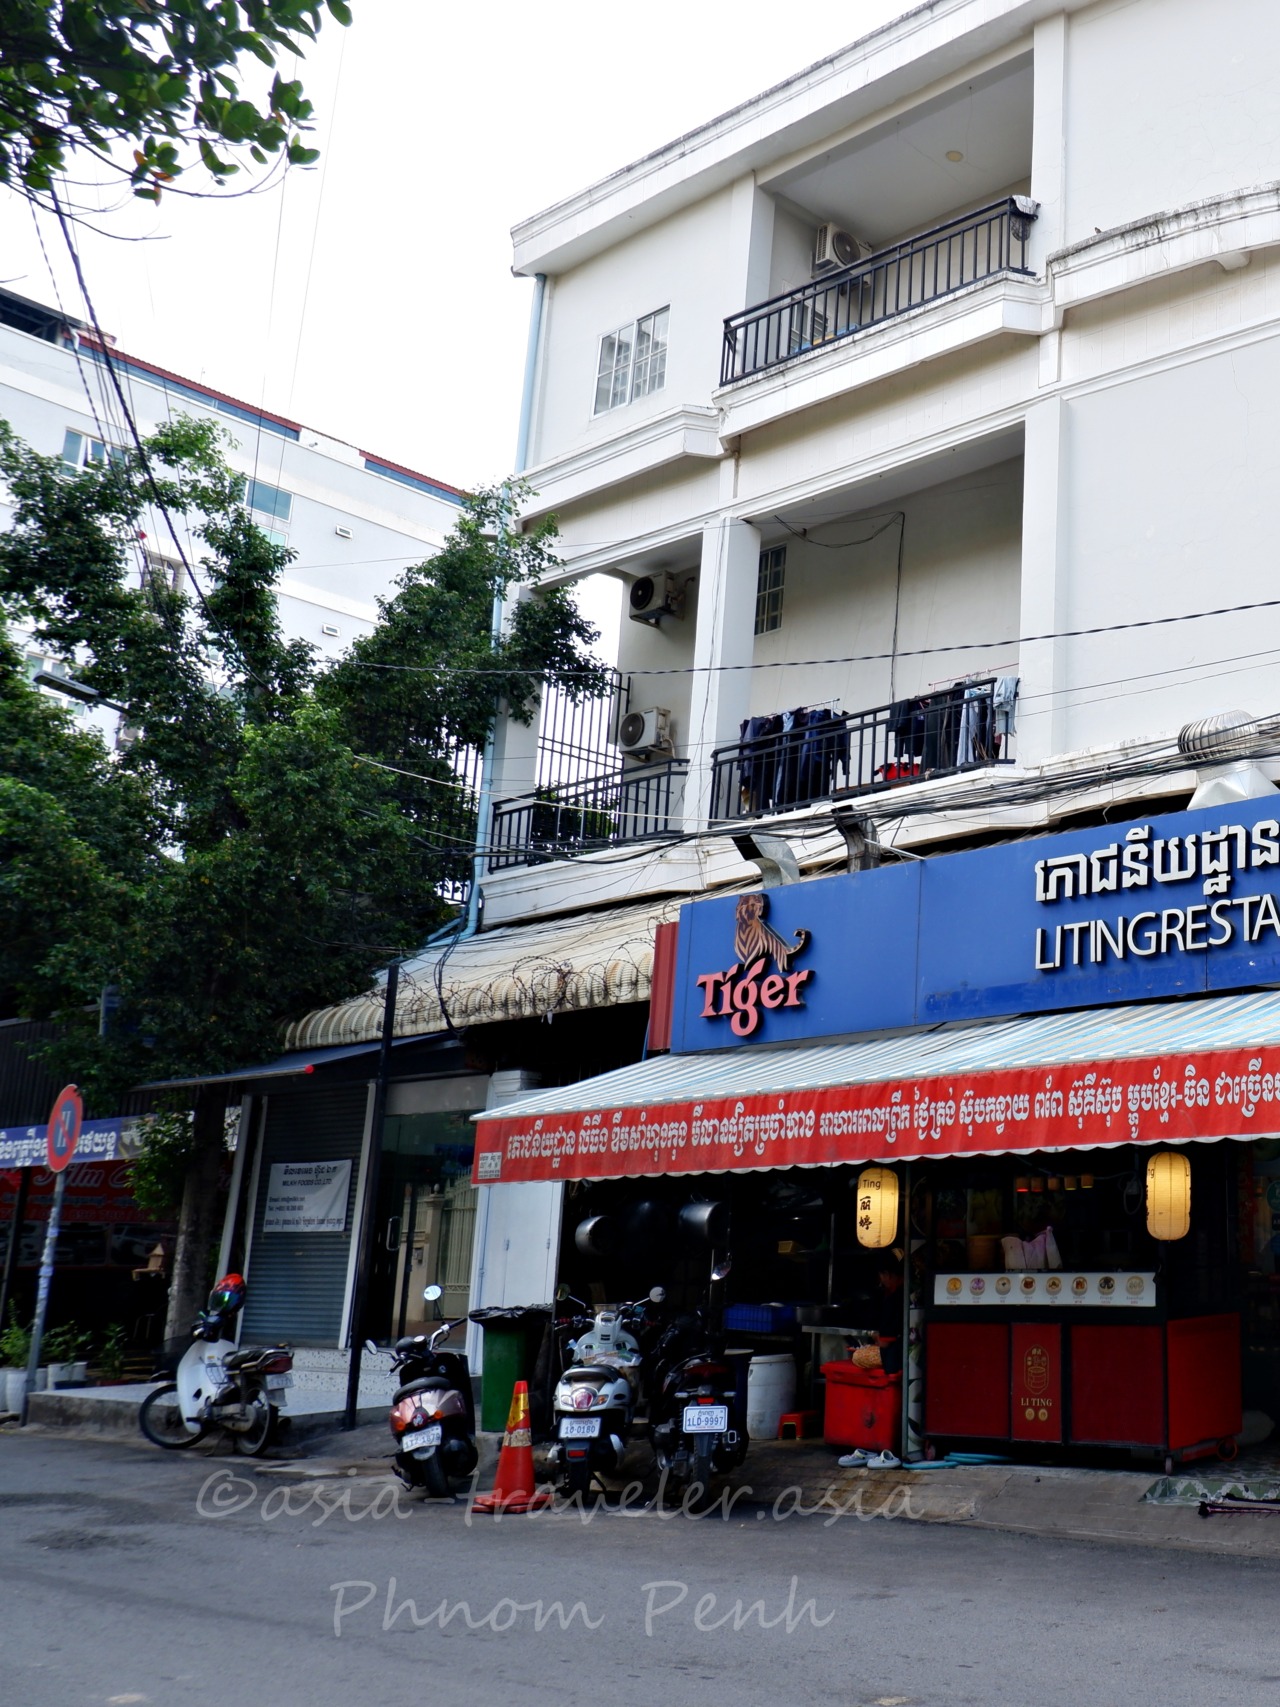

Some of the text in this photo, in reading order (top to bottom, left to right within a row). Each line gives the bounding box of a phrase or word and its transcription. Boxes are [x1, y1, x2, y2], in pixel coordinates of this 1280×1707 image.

[1034, 819, 1280, 902] ភោជនីយដ្ឋាន
[696, 956, 809, 1036] Tiger
[863, 1180, 881, 1190] Ting
[1020, 1397, 1052, 1407] LI TING
[687, 1416, 723, 1427] 1LD-9997
